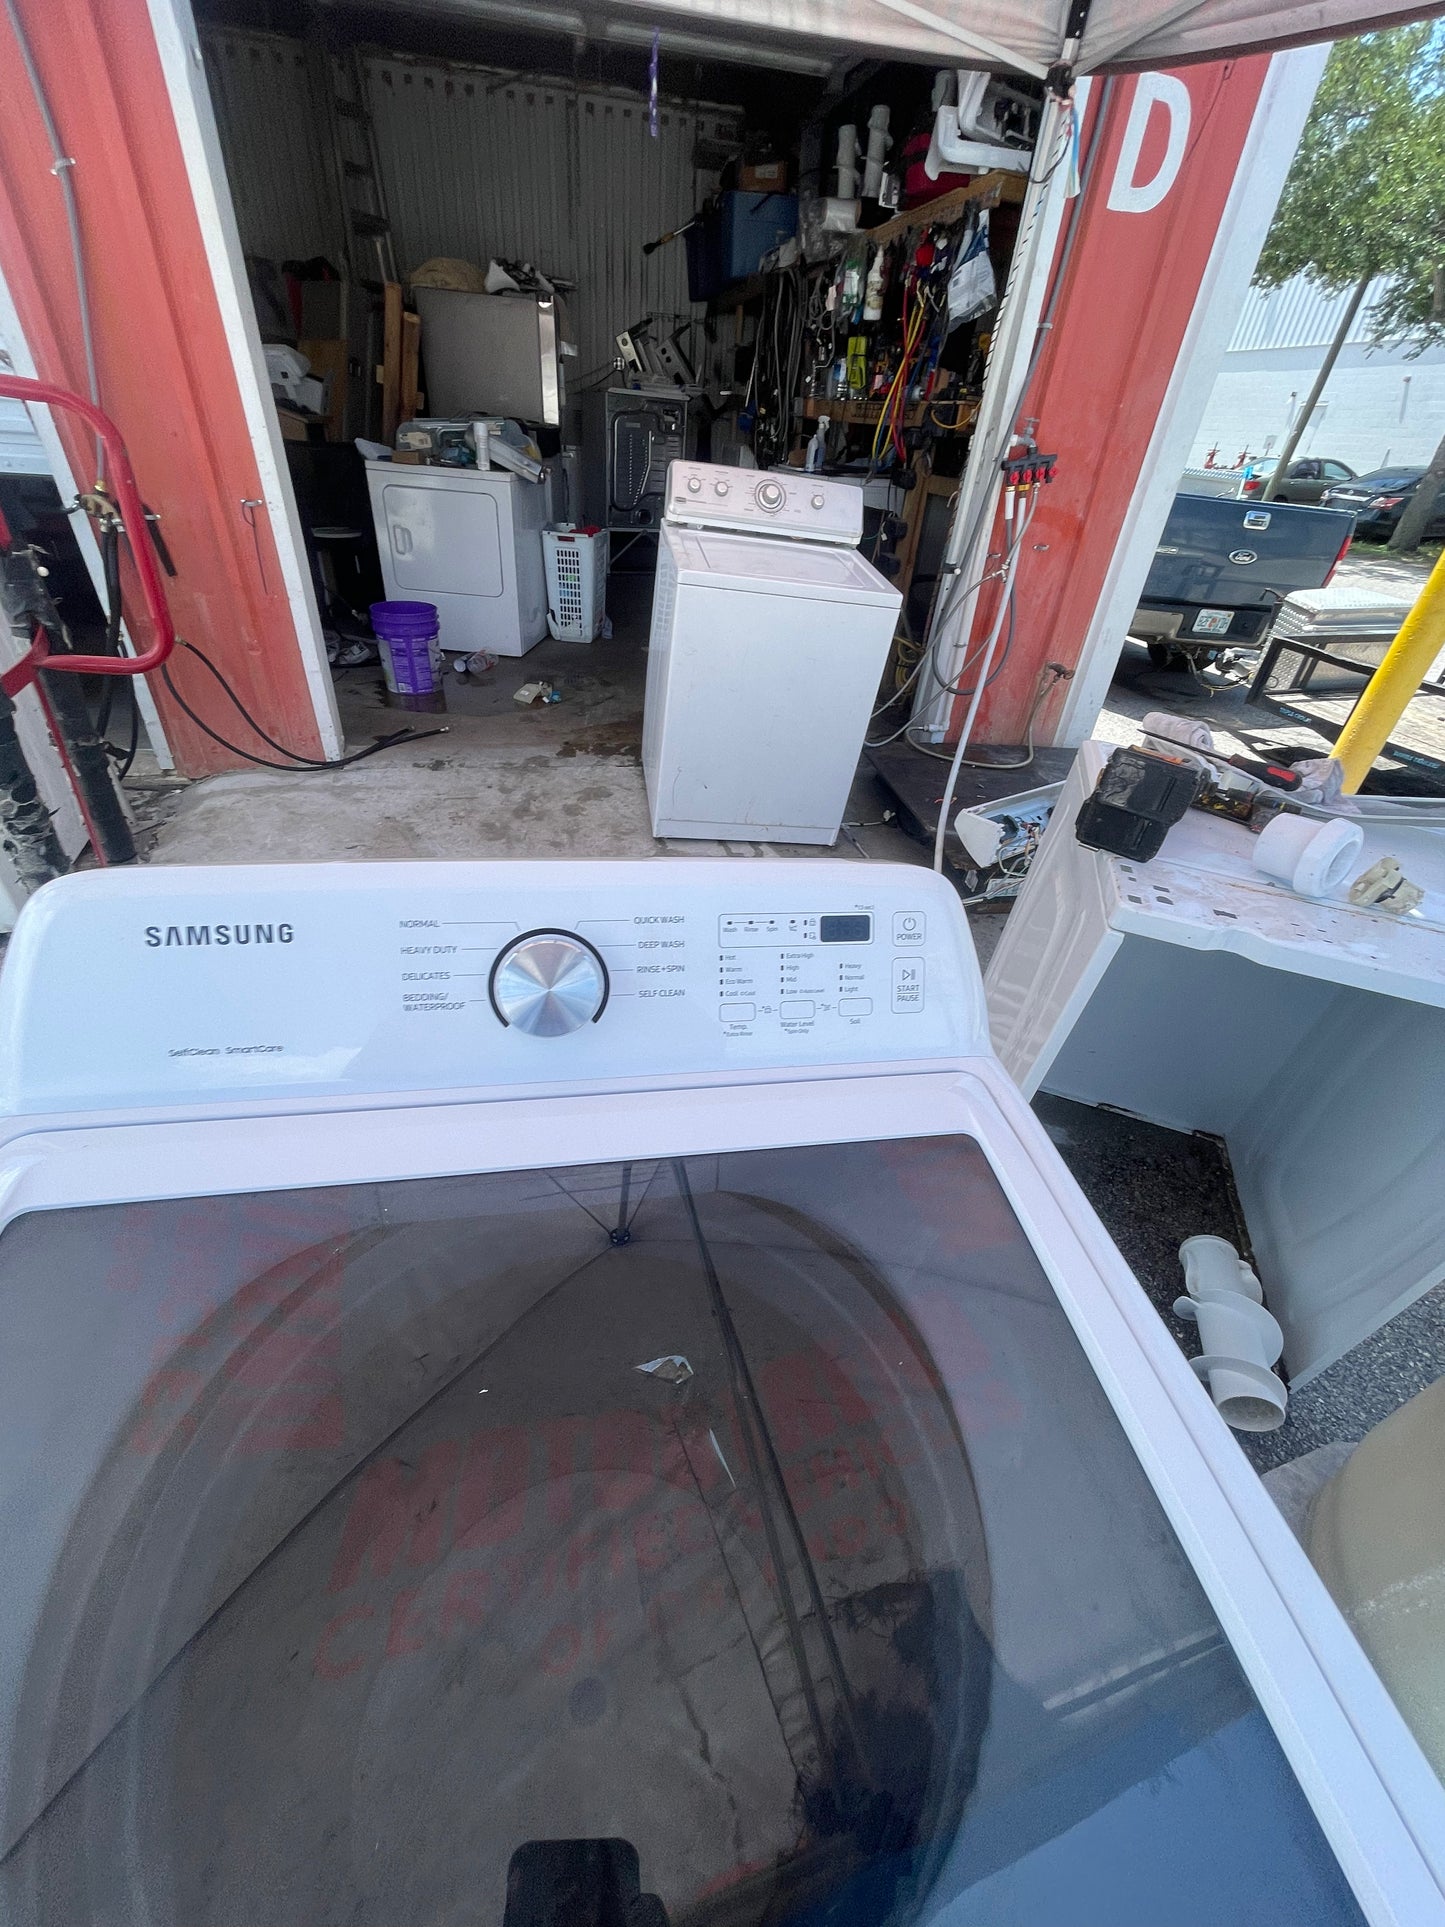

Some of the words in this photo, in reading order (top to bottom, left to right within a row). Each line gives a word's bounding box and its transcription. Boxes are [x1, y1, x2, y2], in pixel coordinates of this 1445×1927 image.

[1107, 71, 1191, 213] D
[400, 920, 440, 928] NORMAL
[634, 916, 659, 924] QUICK
[660, 916, 685, 924] WASH
[145, 923, 295, 947] SAMSUNG
[896, 933, 922, 941] POWER
[638, 941, 659, 949] DEEP
[661, 940, 685, 949] WASH
[401, 946, 431, 954] HEAVY
[433, 945, 458, 954] DUTY
[402, 972, 451, 981] DELICATES
[897, 984, 920, 993] START
[403, 992, 449, 1001] BEDDING/
[638, 990, 658, 998] SELF
[659, 989, 685, 997] CLEAN
[897, 994, 920, 1002] PAUSE
[403, 1002, 466, 1012] WATERPROOF
